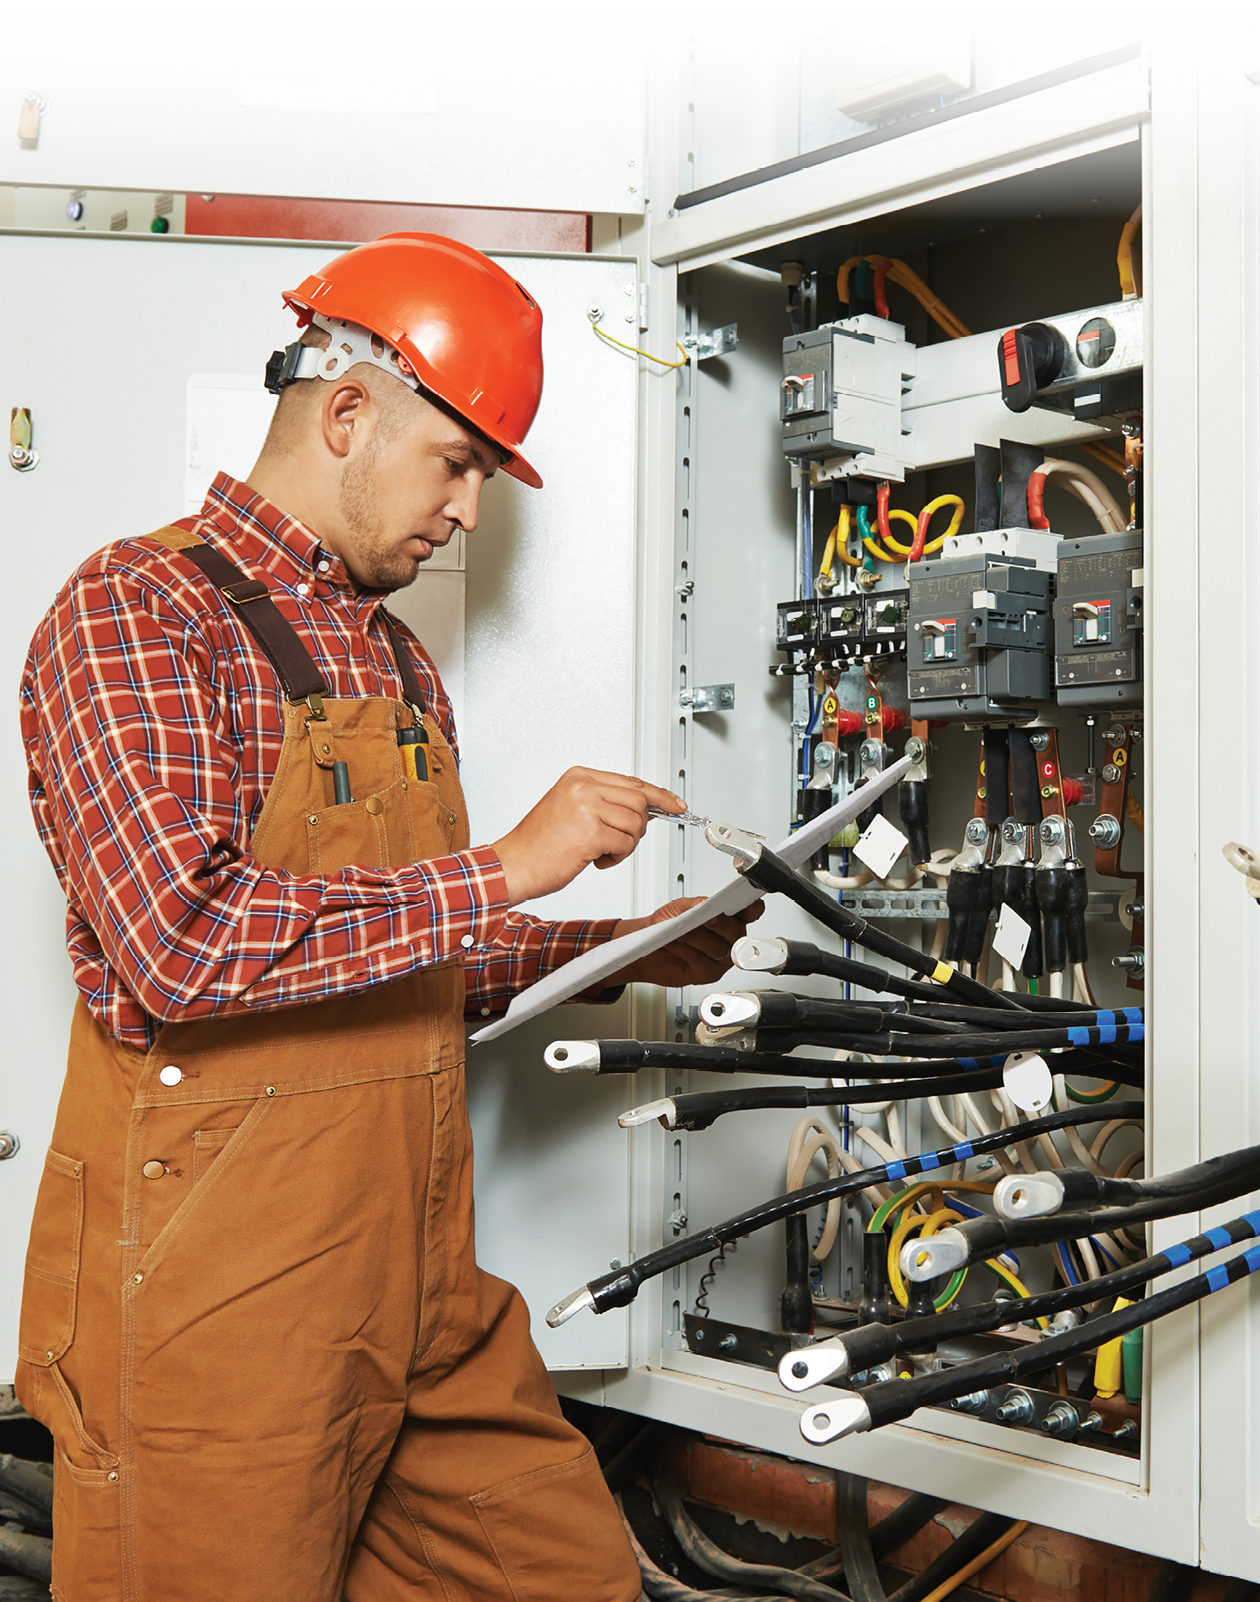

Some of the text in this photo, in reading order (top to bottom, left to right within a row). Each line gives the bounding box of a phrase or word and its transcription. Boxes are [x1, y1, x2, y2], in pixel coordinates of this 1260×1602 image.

[826, 699, 835, 710] A
[868, 697, 876, 709] B
[1115, 750, 1124, 763] A
[1043, 763, 1053, 776] C
